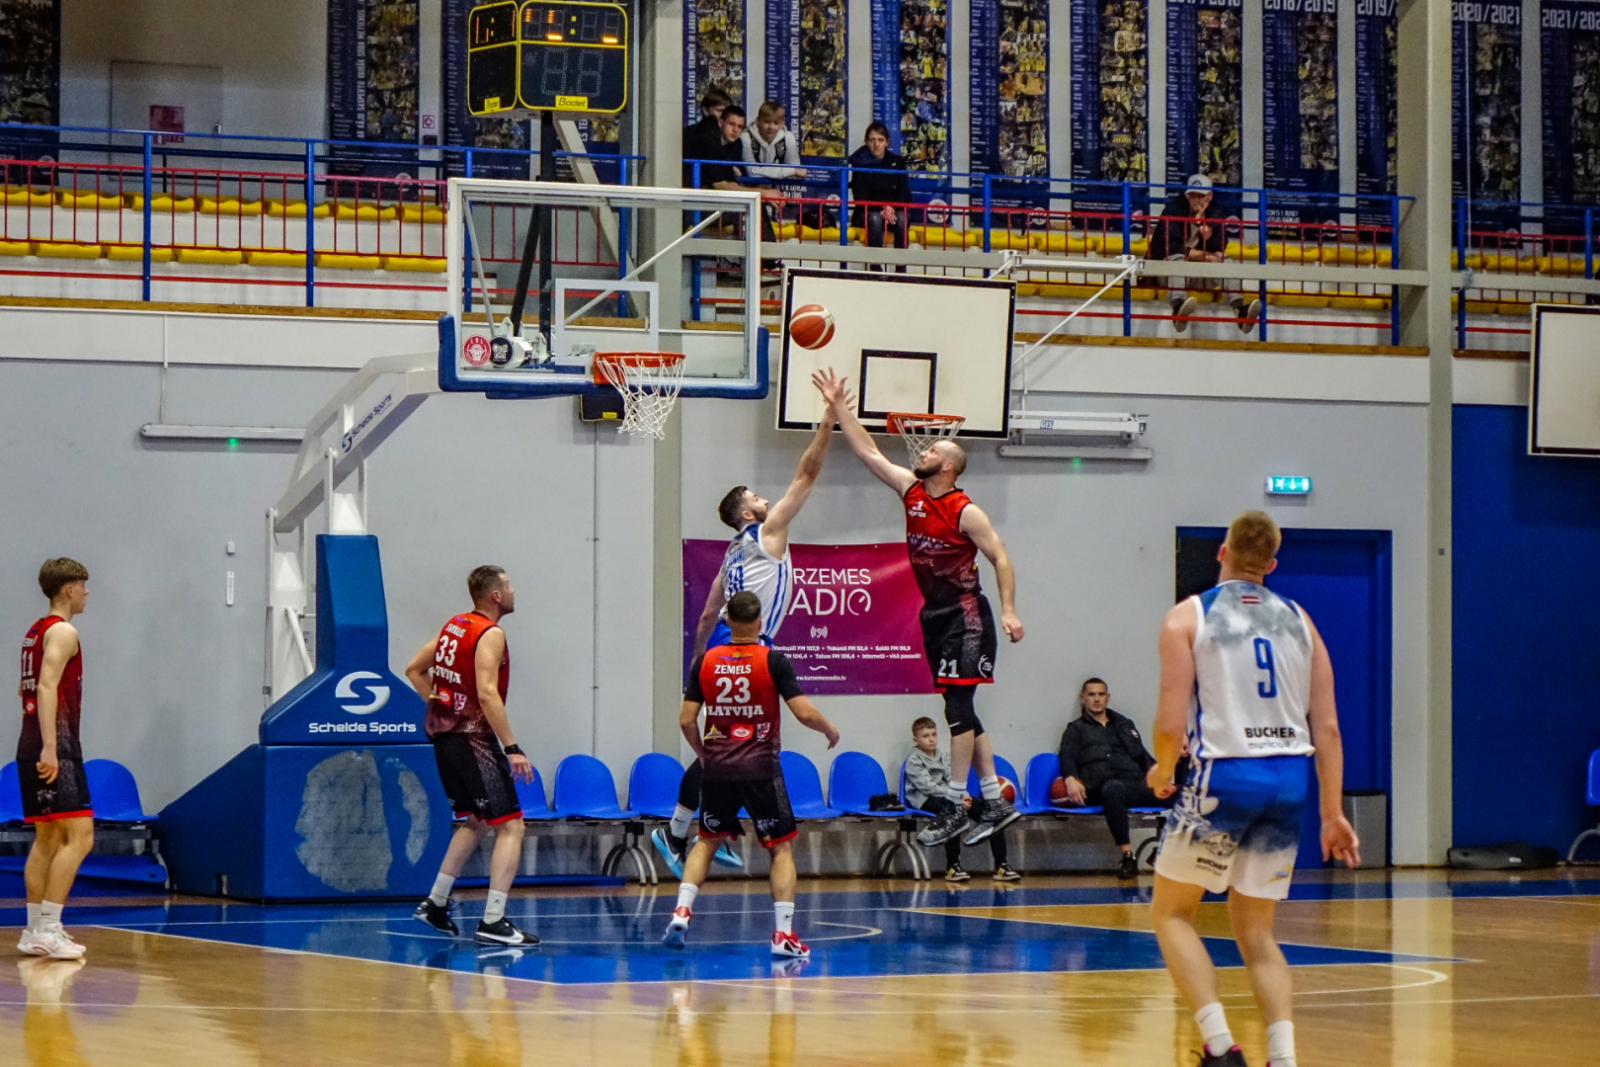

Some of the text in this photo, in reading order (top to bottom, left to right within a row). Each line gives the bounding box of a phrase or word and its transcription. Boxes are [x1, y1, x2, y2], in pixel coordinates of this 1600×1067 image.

[1451, 2, 1520, 25] 2020/2021
[686, 70, 696, 98] SAJŪTAS
[558, 97, 586, 107] Bodet
[352, 394, 392, 438] Schelde Sports
[792, 568, 872, 585] RZEMES
[785, 588, 872, 616] ADIO
[435, 634, 458, 667] 33
[22, 650, 34, 677] 11
[714, 664, 752, 675] ZEMELS
[938, 658, 960, 678] 21
[1253, 637, 1278, 698] 9
[434, 665, 461, 684] TVIJA
[715, 676, 751, 704] 23
[707, 705, 764, 718] LATVIJA
[308, 722, 417, 735] Schelde Sports
[1244, 726, 1296, 738] BUCHER
